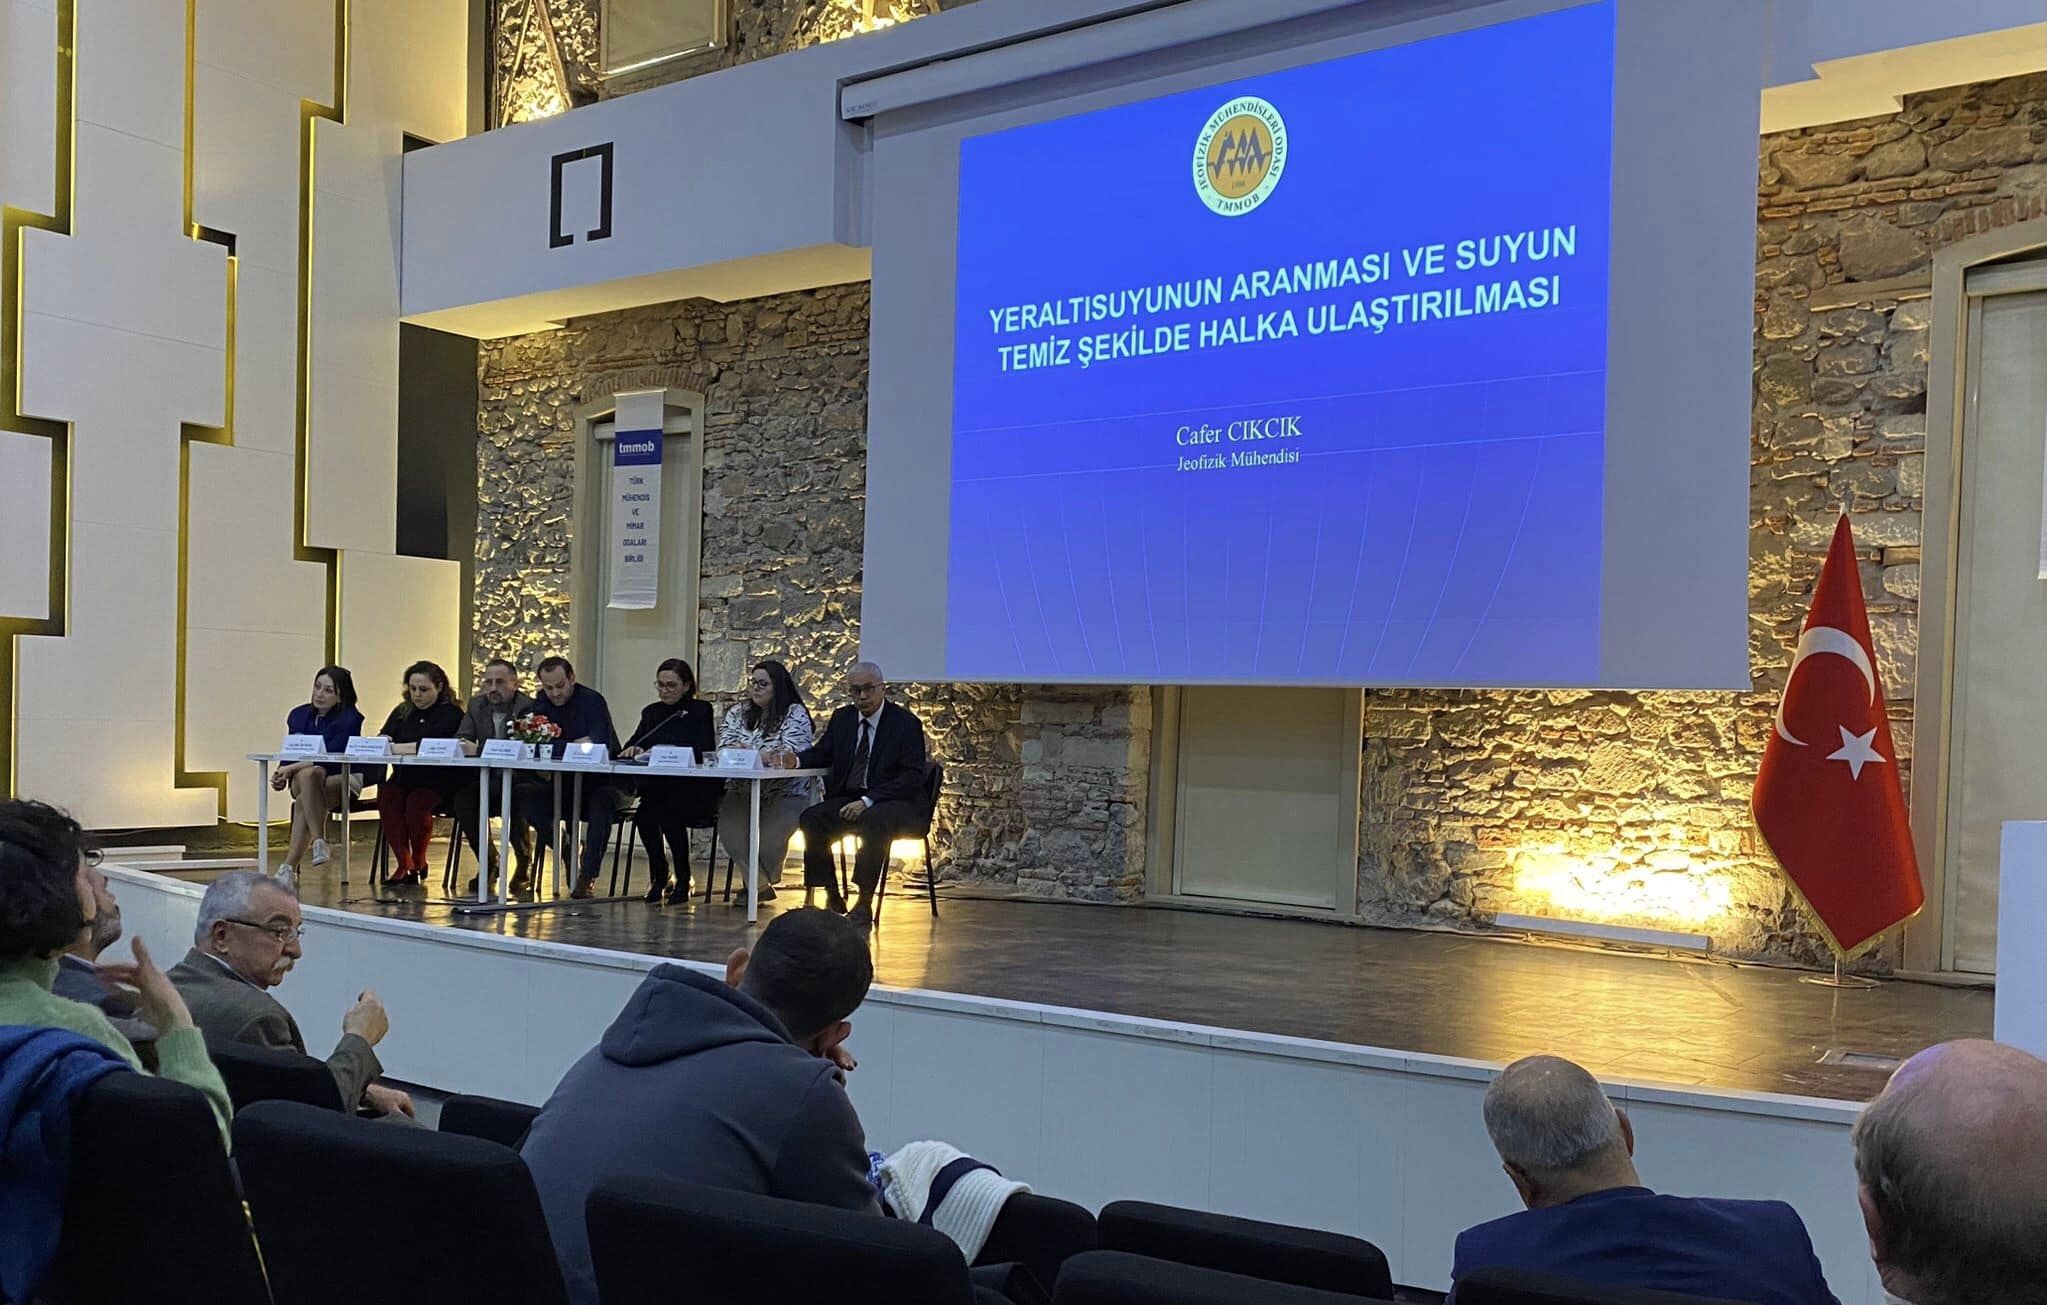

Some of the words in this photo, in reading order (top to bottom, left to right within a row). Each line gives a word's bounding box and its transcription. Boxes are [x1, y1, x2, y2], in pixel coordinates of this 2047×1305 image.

[1196, 132, 1211, 190] JEOFİZİK
[1209, 101, 1282, 135] MÜHENDİSLERİ
[1270, 136, 1284, 177] ODASI
[1216, 193, 1260, 212] TMMOB
[988, 276, 1222, 334] YERALTISUYUNUN
[1230, 252, 1390, 302] ARANMASI
[1402, 244, 1445, 277] VE
[1455, 225, 1576, 271] SUYUN
[998, 335, 1071, 371] TEMİZ
[1078, 323, 1190, 368] ŞEKİLDE
[1200, 309, 1298, 348] HALKA
[1307, 275, 1560, 334] ULAŞTIRILMASI
[1176, 424, 1222, 446] Cafer
[1227, 416, 1303, 441] CIKCIK
[618, 440, 655, 454] tmmob
[1177, 453, 1226, 472] Jeofizik
[1231, 448, 1300, 467] Mühendisi
[631, 508, 640, 516] VE
